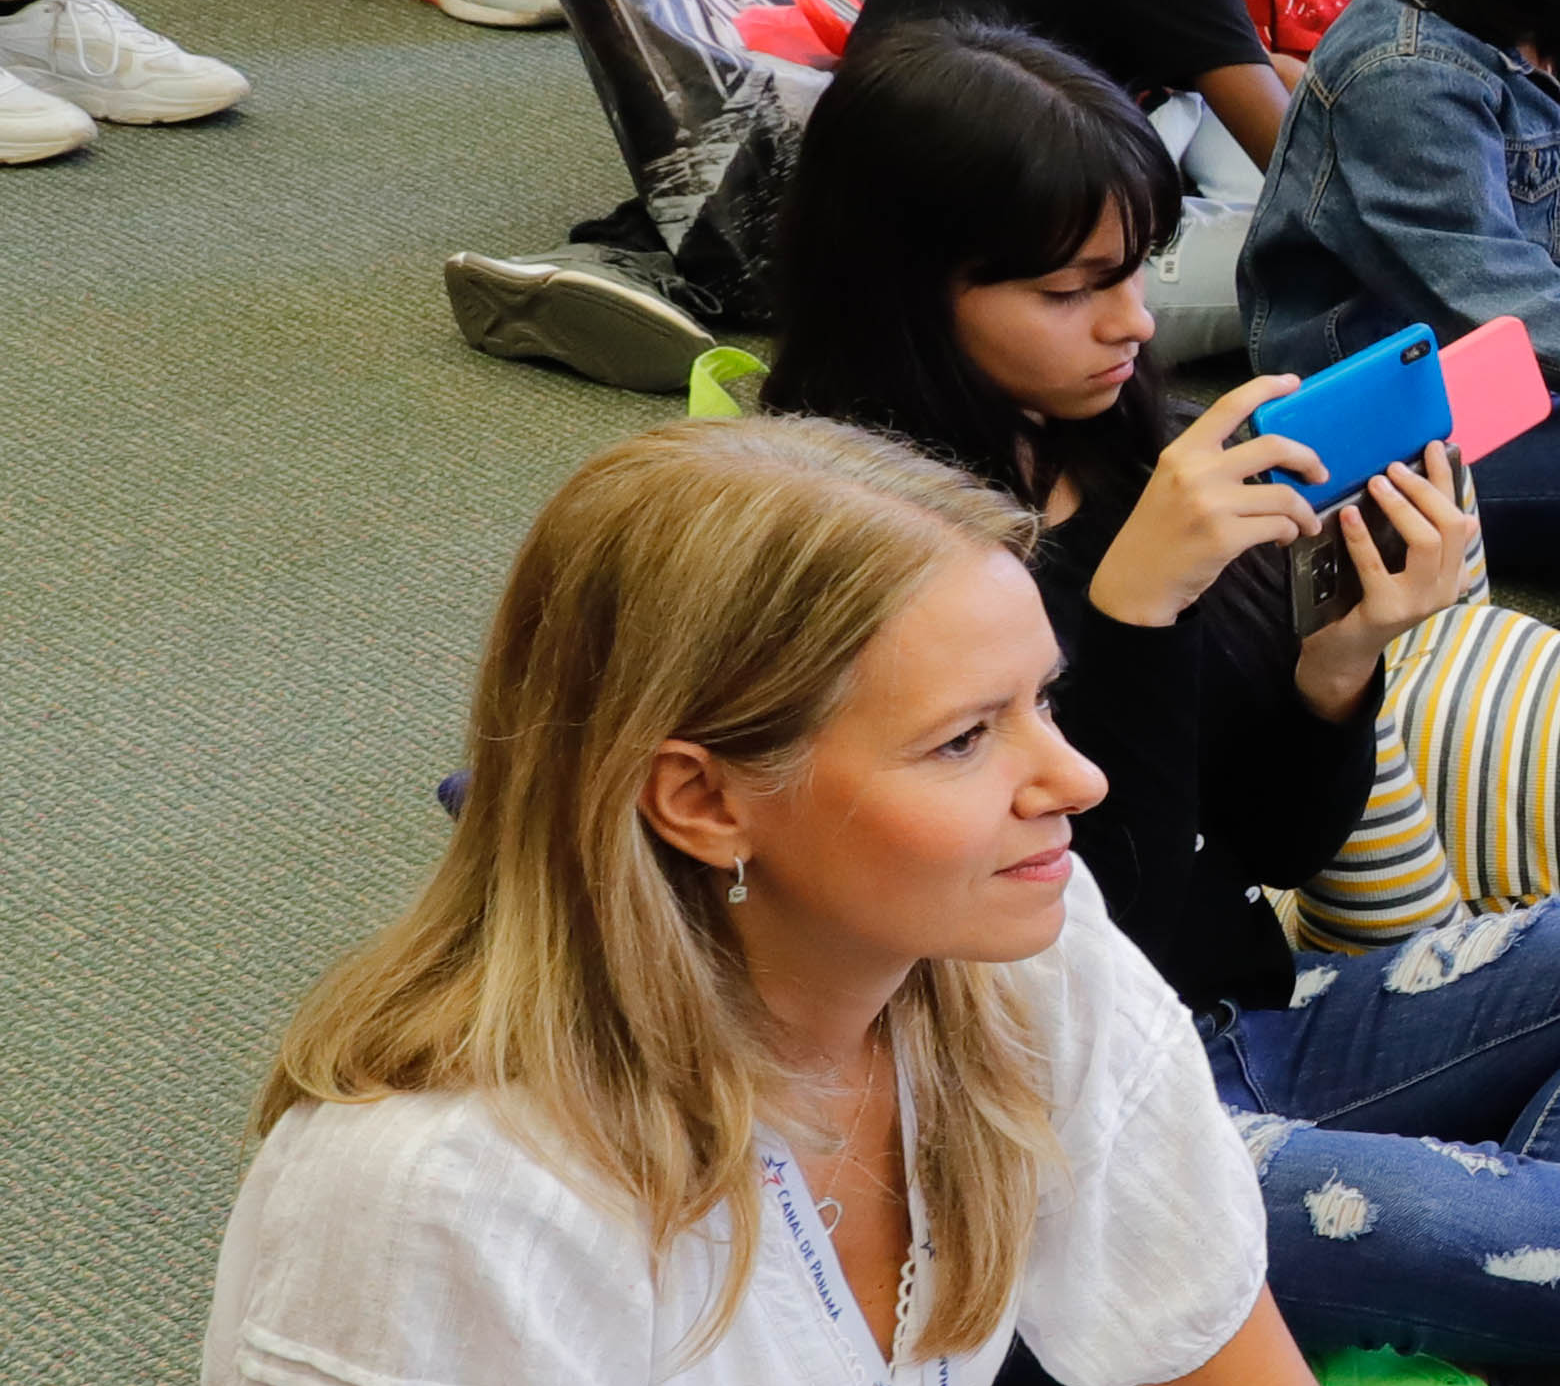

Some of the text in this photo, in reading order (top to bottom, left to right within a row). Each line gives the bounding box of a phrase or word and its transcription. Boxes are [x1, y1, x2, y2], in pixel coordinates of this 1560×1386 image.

[776, 1189, 843, 1324] CANAL DE PANAMÁ
